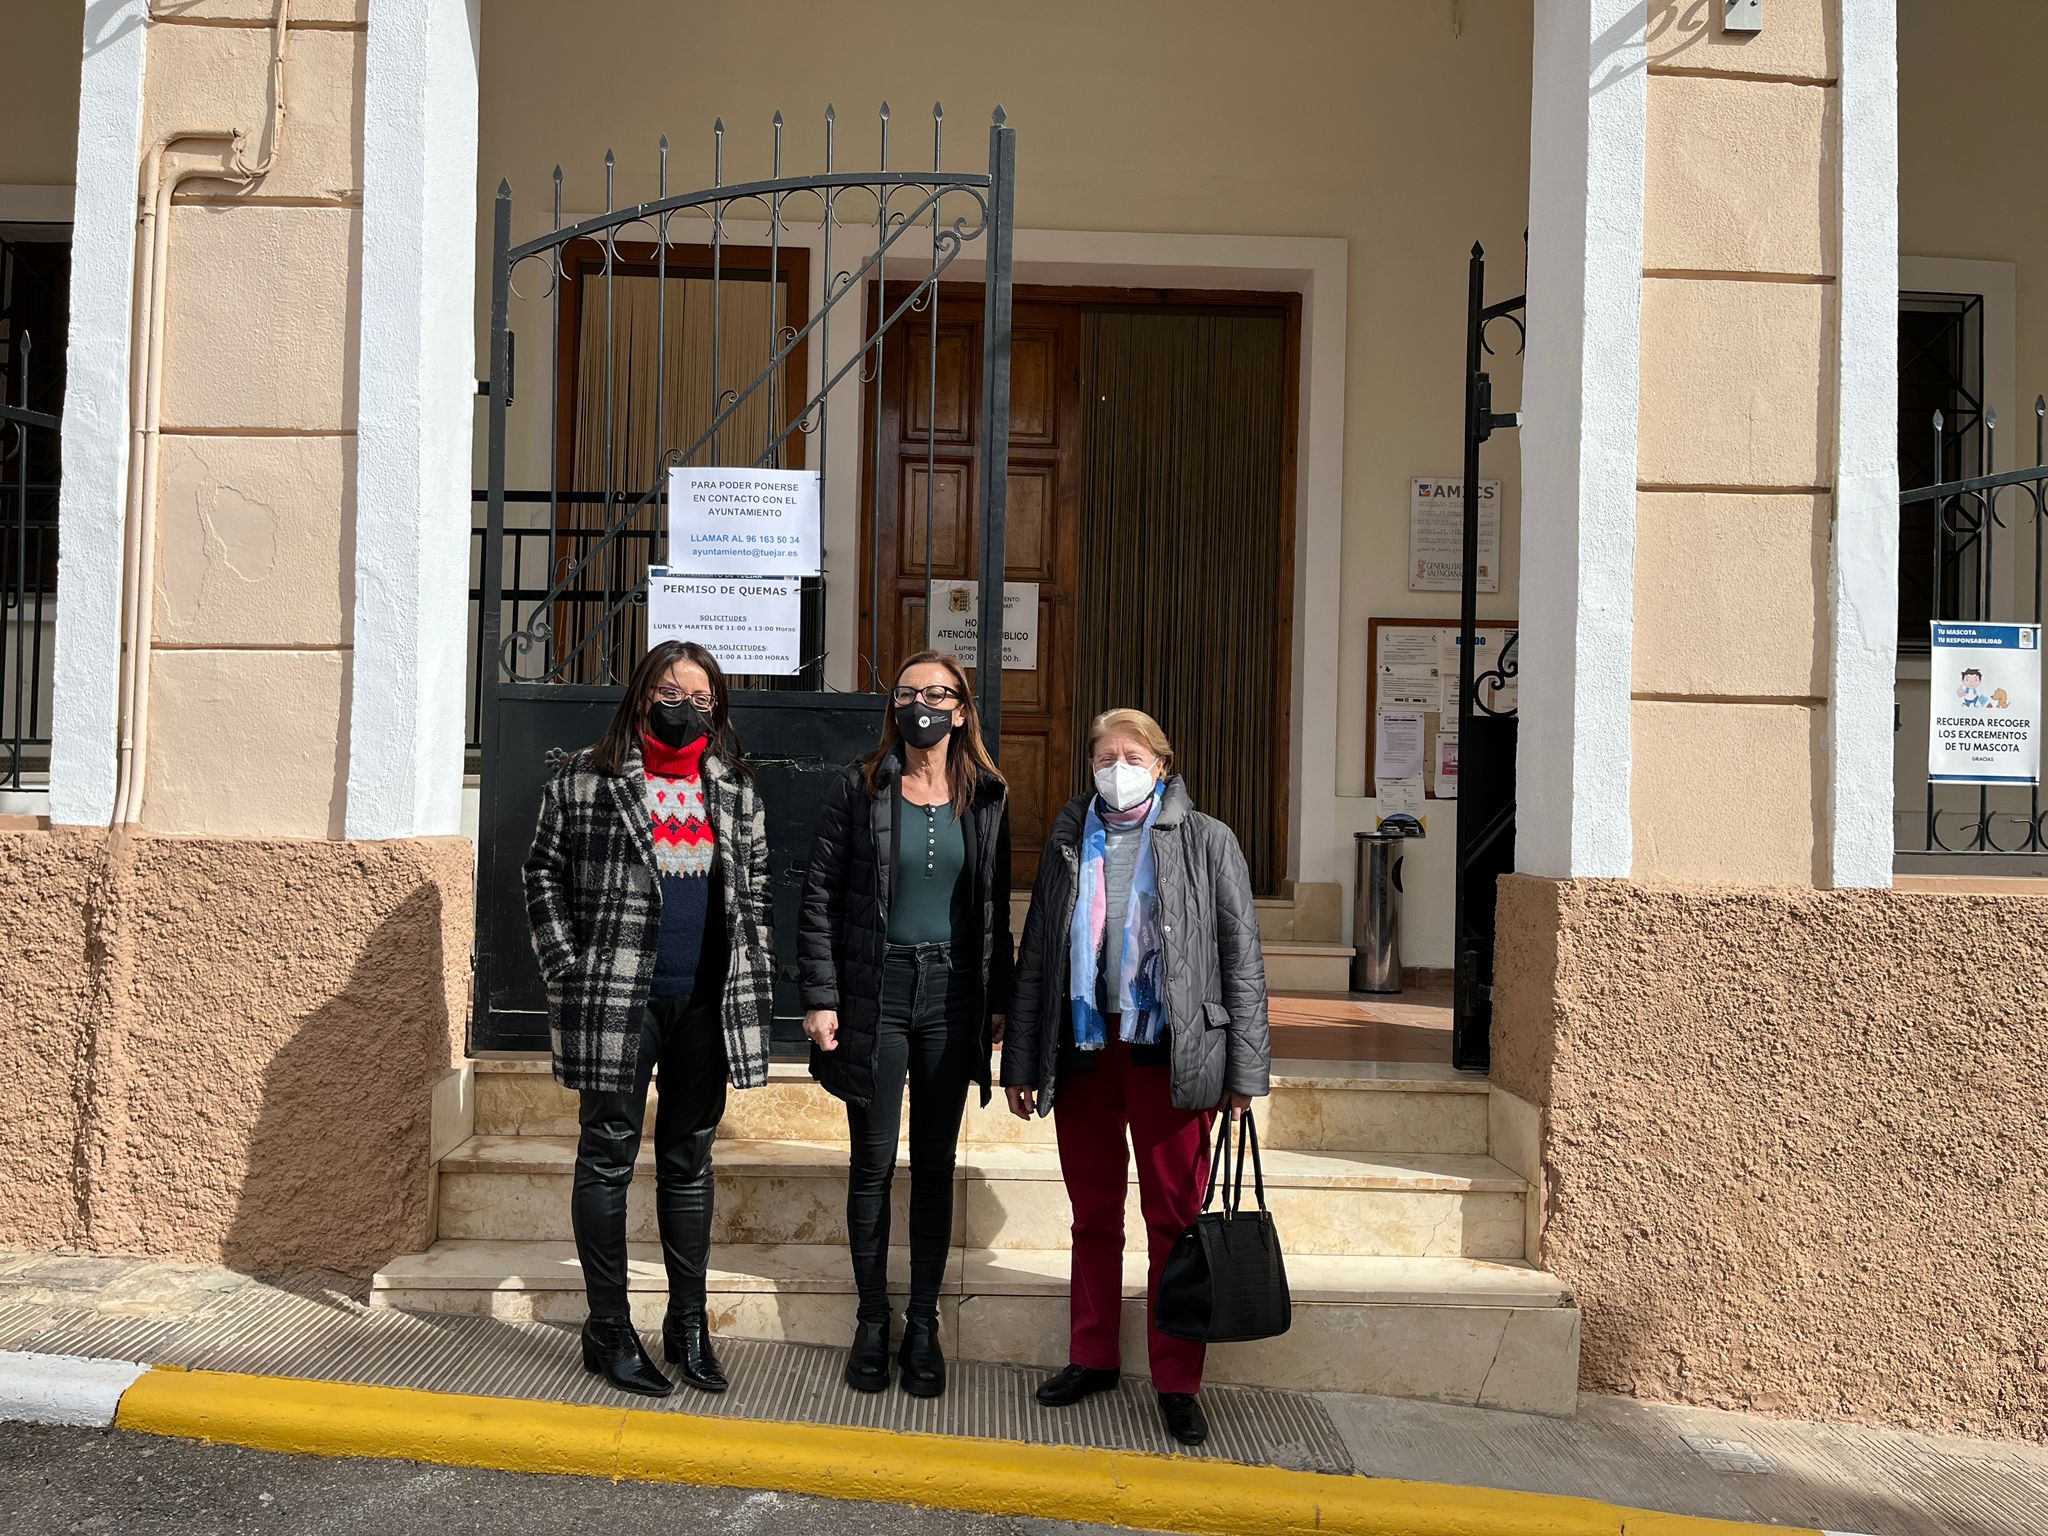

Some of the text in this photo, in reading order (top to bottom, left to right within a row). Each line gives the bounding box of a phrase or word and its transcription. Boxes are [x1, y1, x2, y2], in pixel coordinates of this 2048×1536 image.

[691, 481, 799, 491] PARA PODER PONERSE
[1434, 485, 1495, 499] AMS
[693, 494, 797, 505] EN CONTACTO CON EL
[708, 508, 782, 517] AYUNTAMIENTO
[690, 534, 800, 544] LLAMAR AL 96 163 50 34
[692, 548, 798, 558] ayuntamiento@tuejar.es
[663, 585, 788, 596] PERMISO DE QUEMAS
[937, 629, 978, 639] ATENCIÓN
[1936, 717, 2031, 728] RECUERDA RECOGER
[1938, 730, 2028, 741] LOS EXCREMENTOS
[1945, 743, 2020, 752] DE TU MASCOTA
